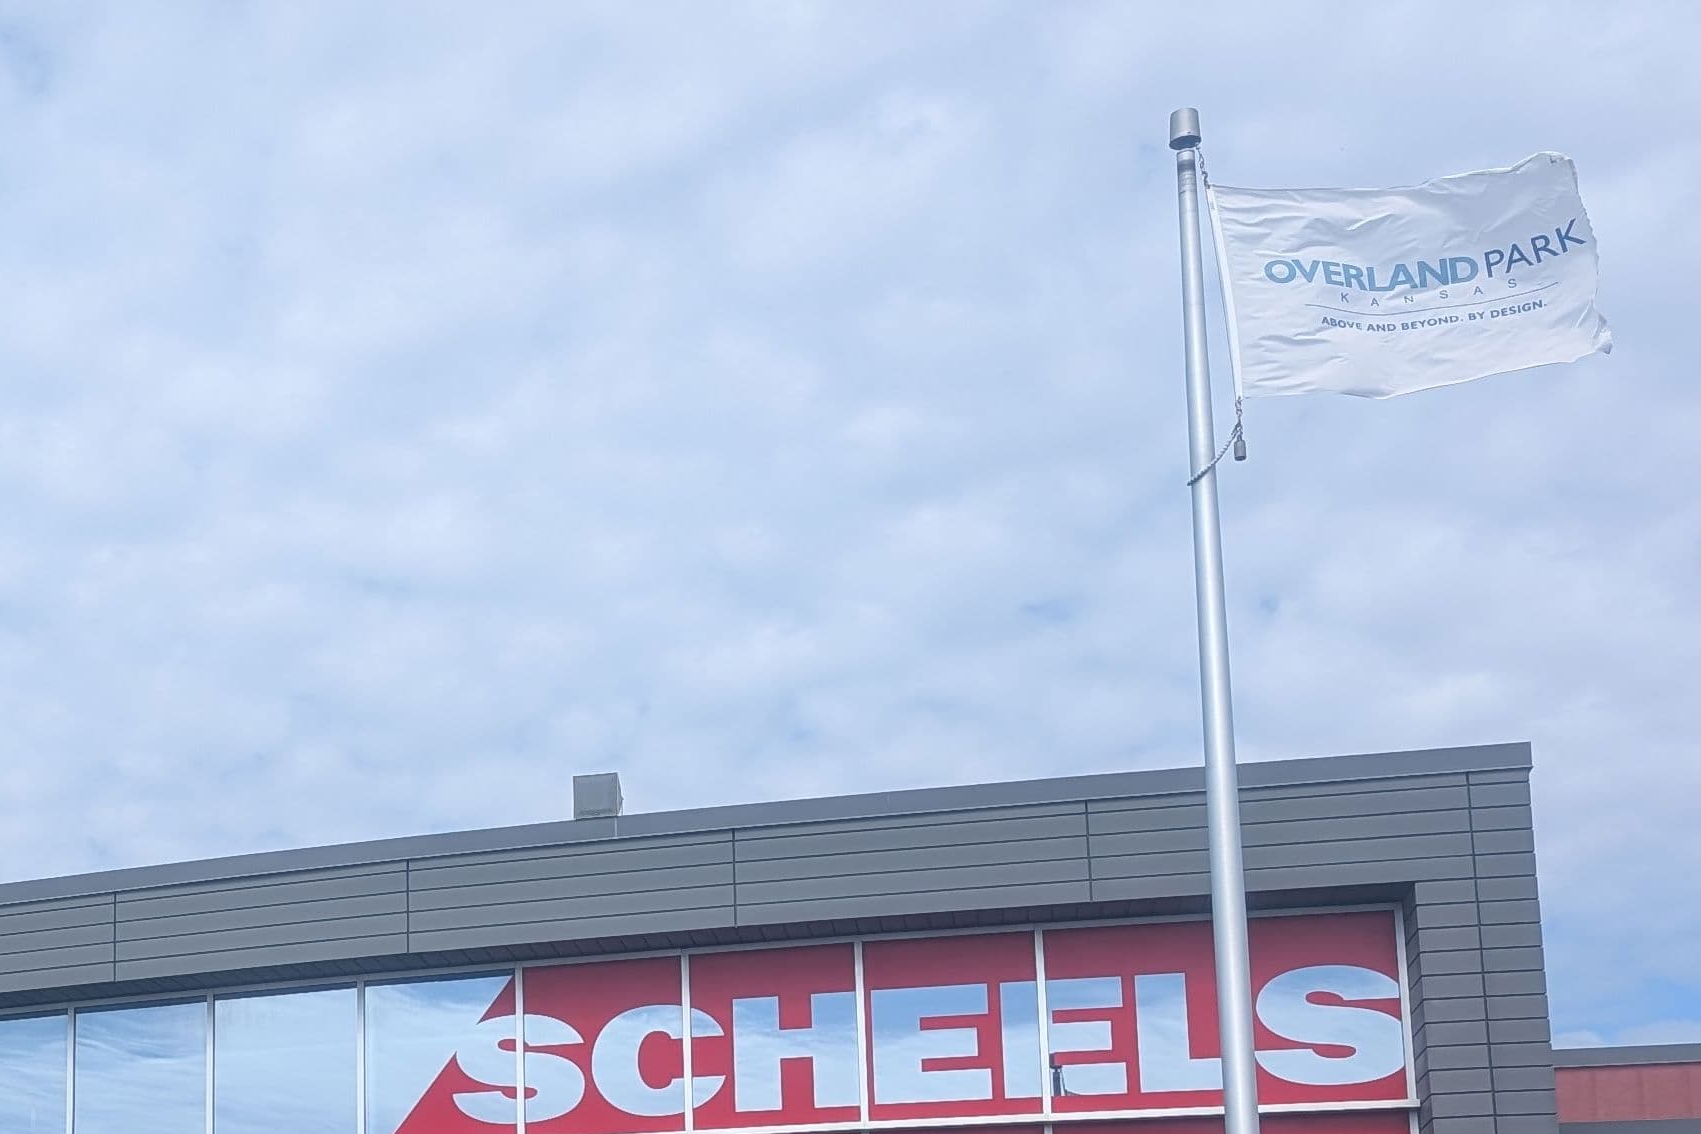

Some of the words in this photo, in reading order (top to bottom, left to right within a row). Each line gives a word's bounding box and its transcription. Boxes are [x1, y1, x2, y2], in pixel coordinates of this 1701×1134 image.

[1264, 256, 1479, 292] OVERLAND
[1483, 217, 1587, 278] PARK
[1321, 315, 1364, 332] ABOVE
[1366, 322, 1397, 332] AND
[1467, 310, 1485, 322] BY
[1489, 299, 1548, 319] DESIGN.
[1340, 278, 1517, 307] KANSAS
[452, 963, 1406, 1126] SCHEELS
